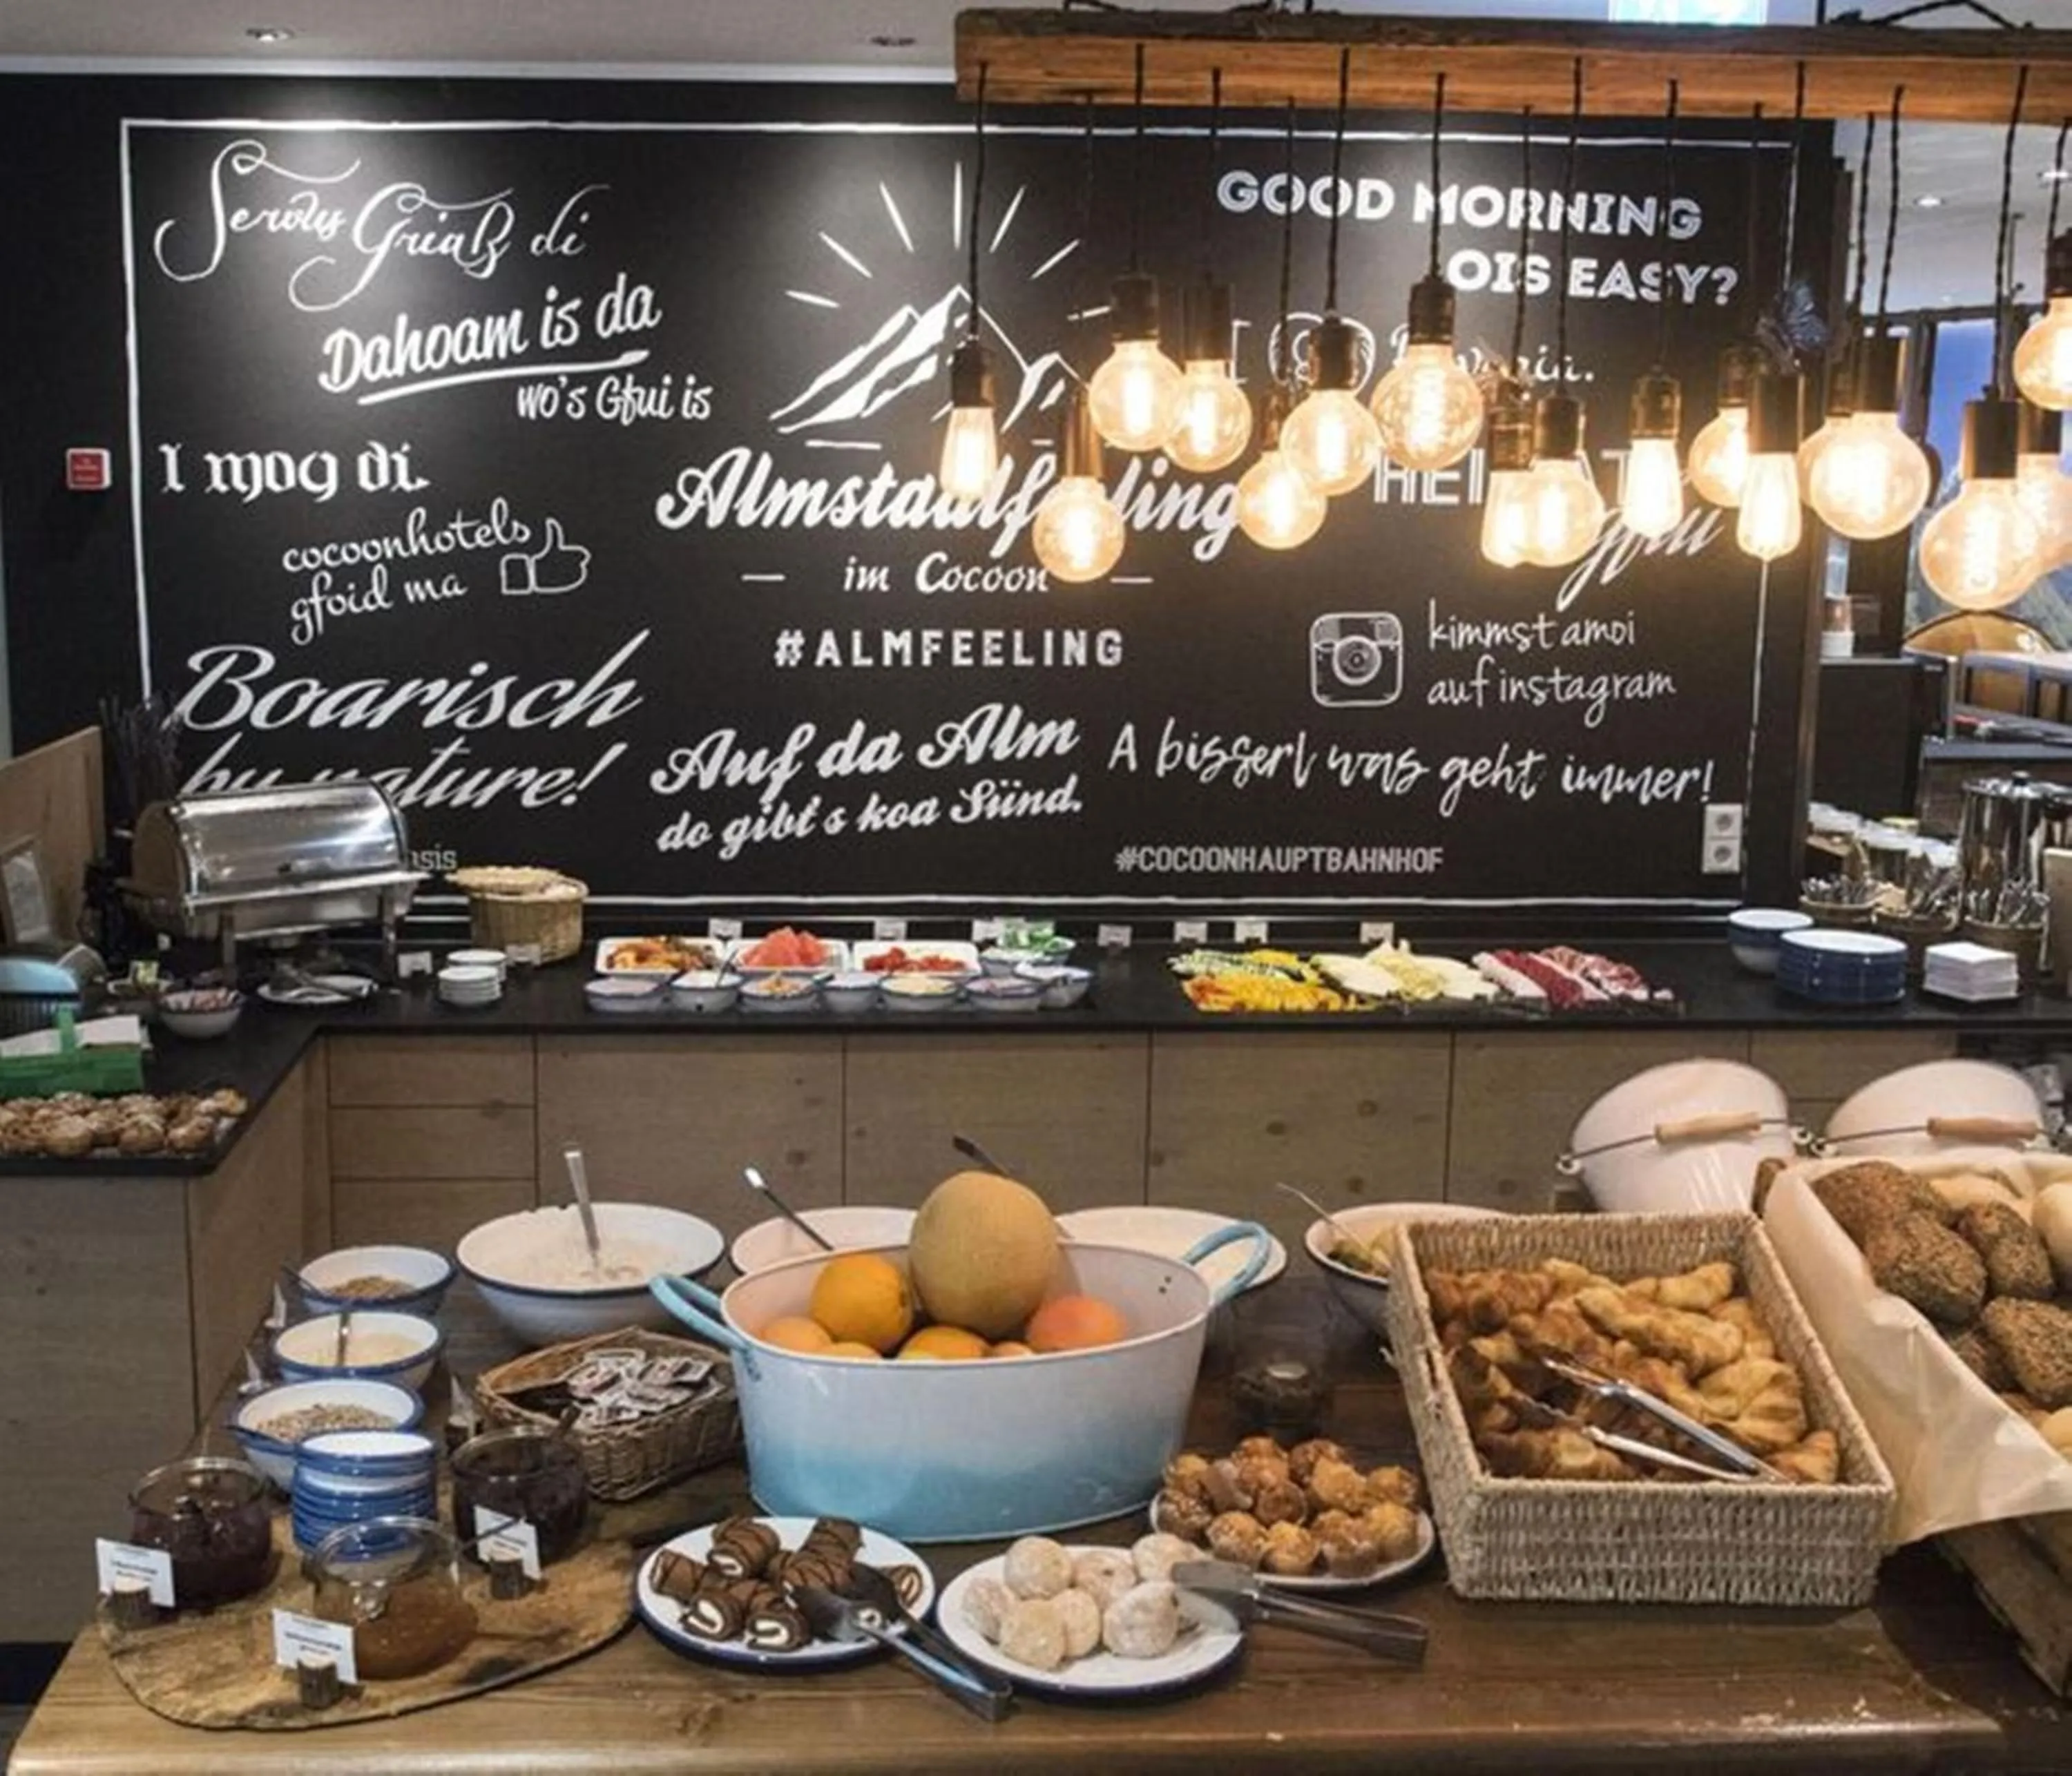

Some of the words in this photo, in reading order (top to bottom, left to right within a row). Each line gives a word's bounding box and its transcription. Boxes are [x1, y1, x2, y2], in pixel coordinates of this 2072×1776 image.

[1216, 169, 1394, 220] GOOD
[1412, 179, 1702, 239] MORNING
[289, 183, 514, 311] Griaß
[530, 185, 610, 255] di
[1447, 249, 1551, 295] OIS
[1568, 258, 1738, 305] EASY?
[318, 309, 528, 393] Dahoam
[539, 284, 582, 349] is
[595, 273, 662, 334] da
[517, 374, 587, 421] wo's
[595, 372, 675, 427] Gfui
[681, 374, 713, 420] is
[158, 442, 186, 493] I
[204, 450, 339, 503] mog
[282, 496, 532, 572] cocoonhotels
[291, 563, 394, 645] gfoid
[403, 574, 468, 604] ma
[843, 557, 890, 593] im
[915, 552, 1049, 593] Cocoon
[161, 629, 650, 732] Boarisch
[774, 629, 1123, 667] #ALMFEELING
[1427, 653, 1495, 708] auf
[1499, 666, 1677, 728] instagram
[650, 723, 816, 804] Auf
[816, 720, 903, 778] da
[917, 702, 1080, 768] Alm
[1108, 722, 1138, 772] A
[1156, 716, 1316, 789] bisserl
[1327, 744, 1430, 795] was
[1439, 742, 1546, 818] geht
[1561, 754, 1714, 806] immer!
[657, 811, 713, 851] do
[856, 793, 941, 833] koa
[950, 773, 1082, 823] Sünd.
[1115, 846, 1445, 873] #COCOONHAUPTBAHNHOF
